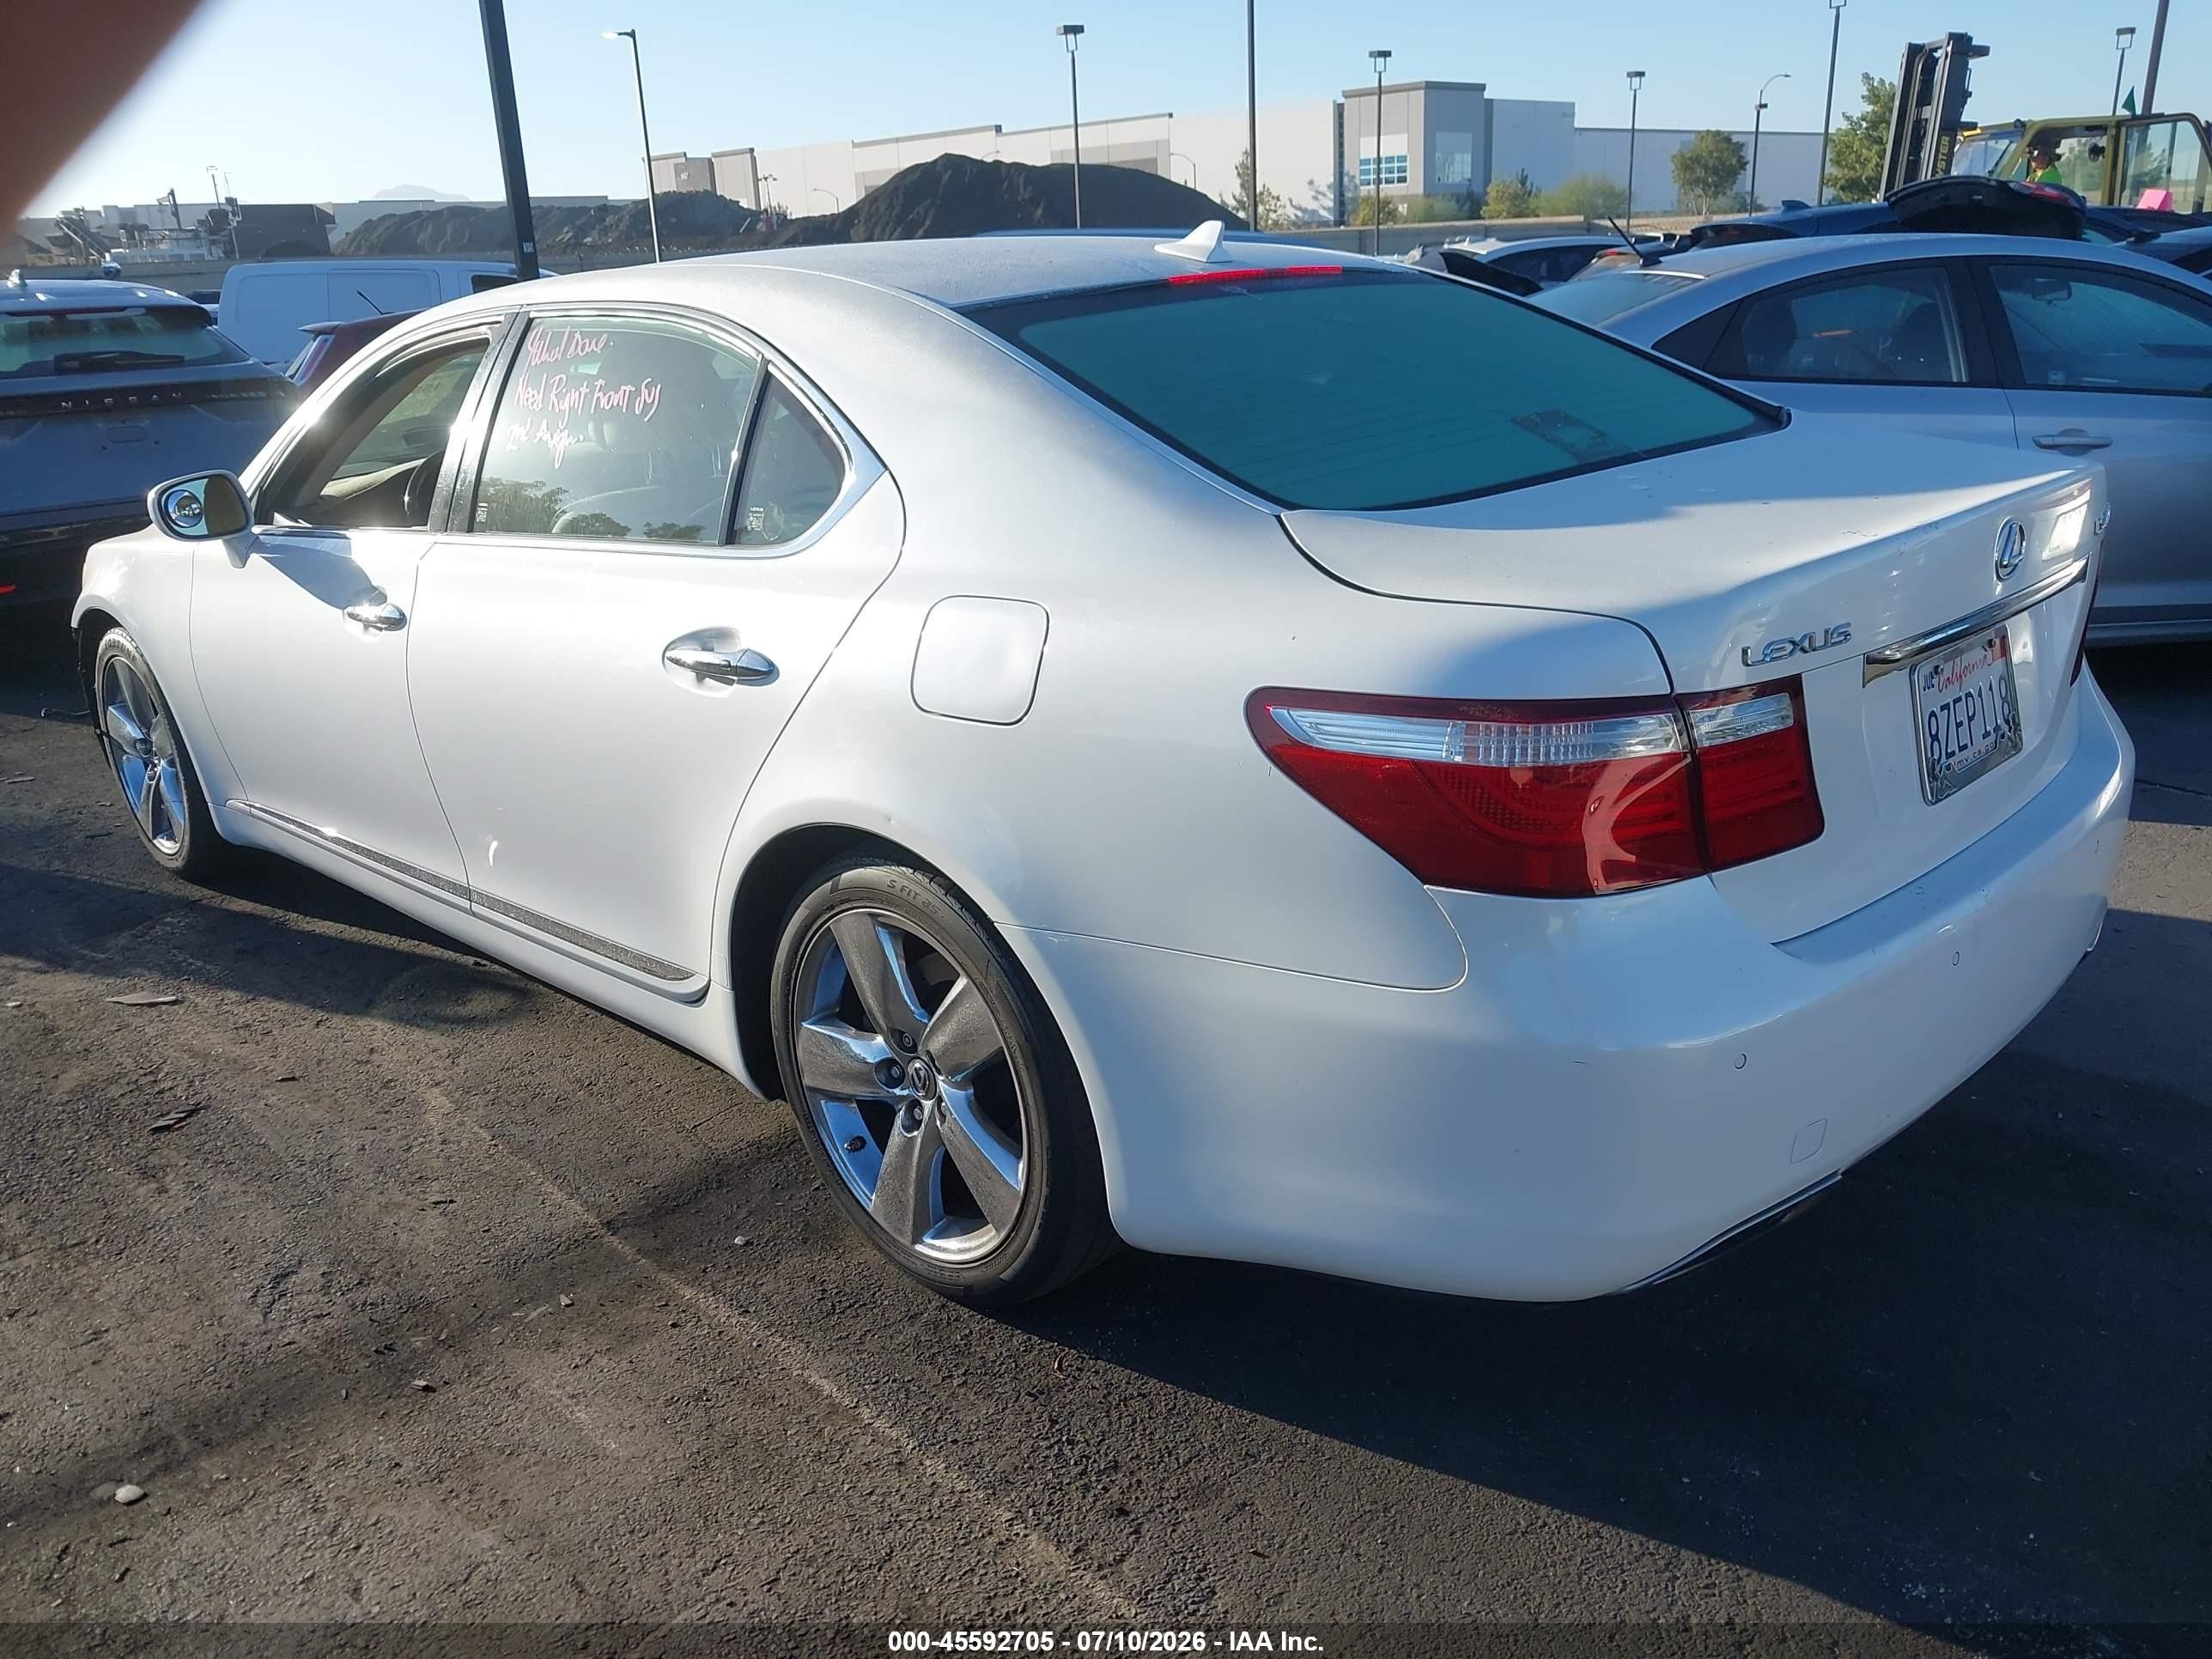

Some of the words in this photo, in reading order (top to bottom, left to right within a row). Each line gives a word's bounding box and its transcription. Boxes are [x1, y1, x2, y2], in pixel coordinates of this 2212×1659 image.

[61, 392, 182, 409] NISSAN
[514, 372, 548, 412] Need
[1741, 622, 1852, 667] LEXUS
[1936, 653, 1993, 693] California
[1927, 674, 2012, 767] 8ZEP118
[886, 878, 898, 890] S
[899, 884, 921, 901] FIT
